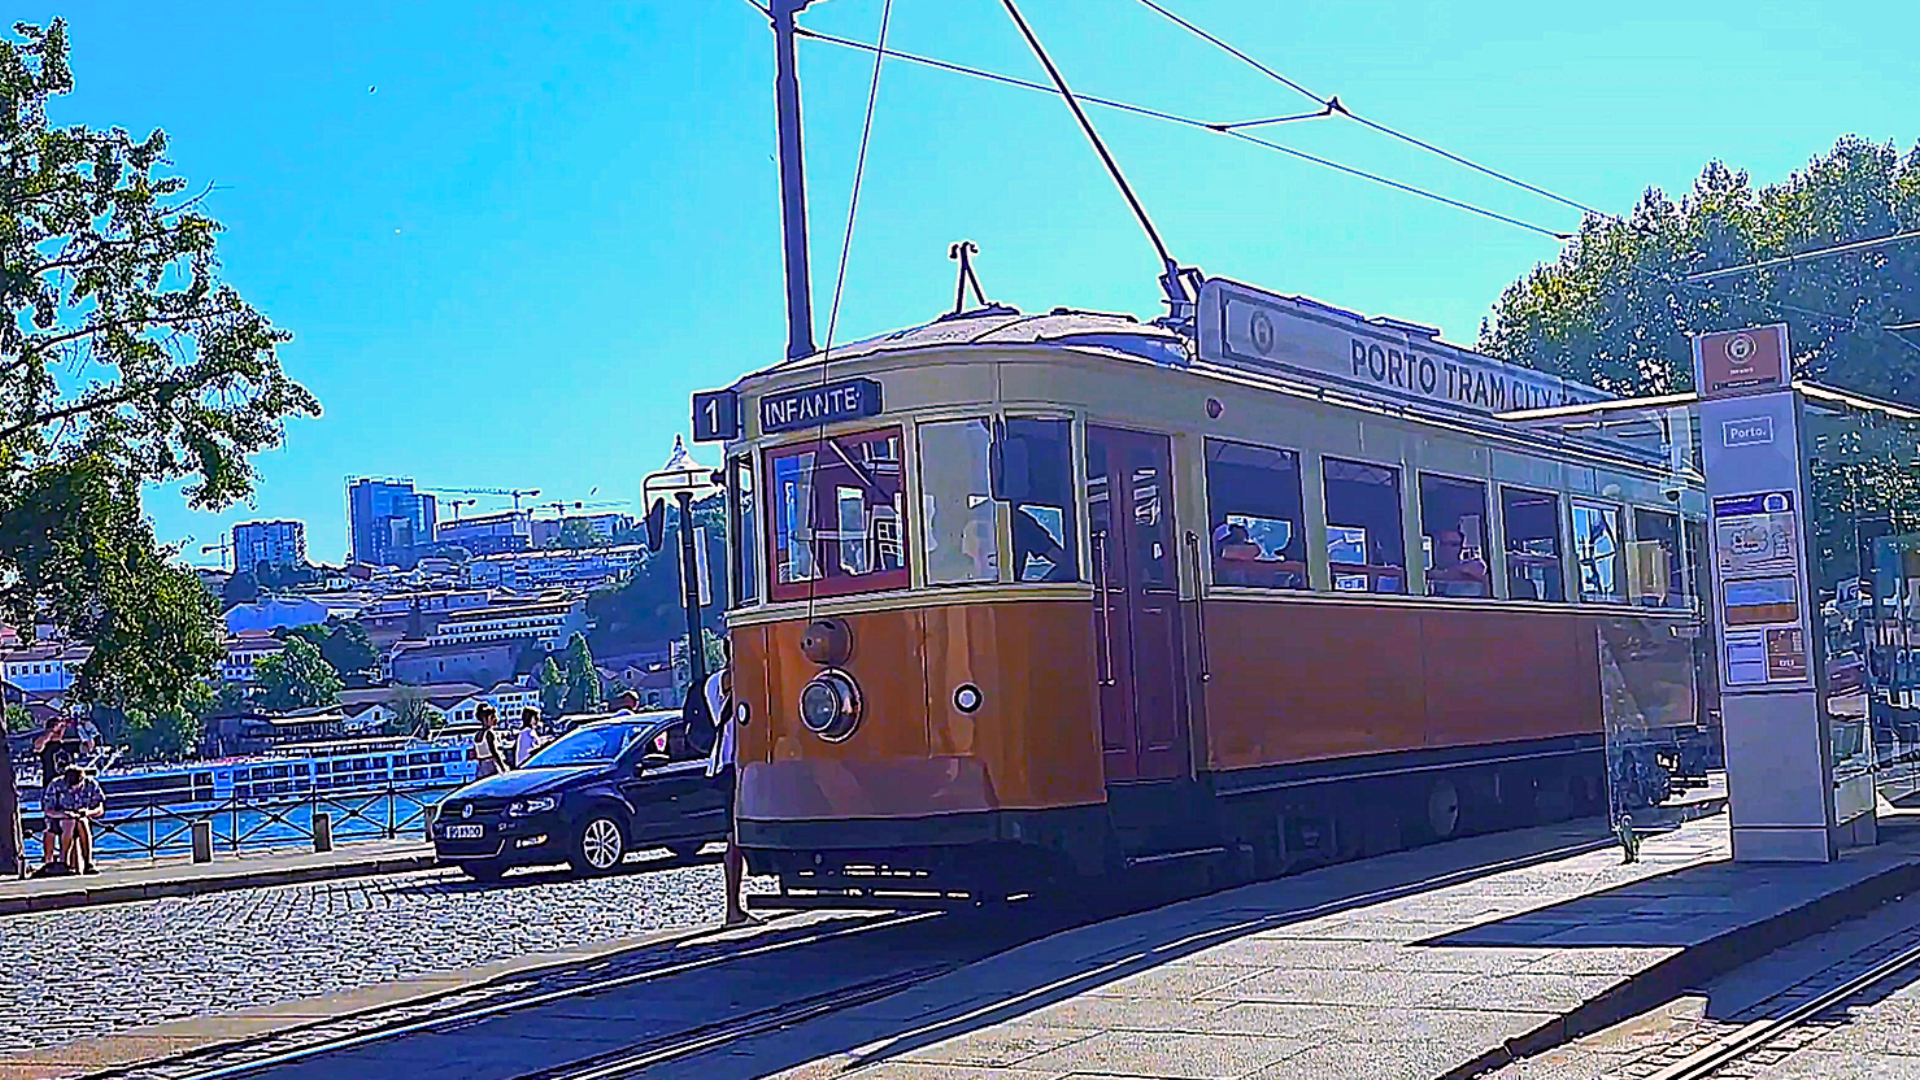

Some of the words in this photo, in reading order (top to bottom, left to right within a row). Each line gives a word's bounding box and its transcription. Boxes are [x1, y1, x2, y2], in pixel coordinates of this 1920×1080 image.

[1351, 339, 1437, 393] PORTO
[1445, 364, 1504, 410] TRAM
[1512, 381, 1552, 411] CITY
[705, 399, 718, 434] 1
[765, 387, 856, 427] INFANTE
[1731, 427, 1766, 439] Porto.
